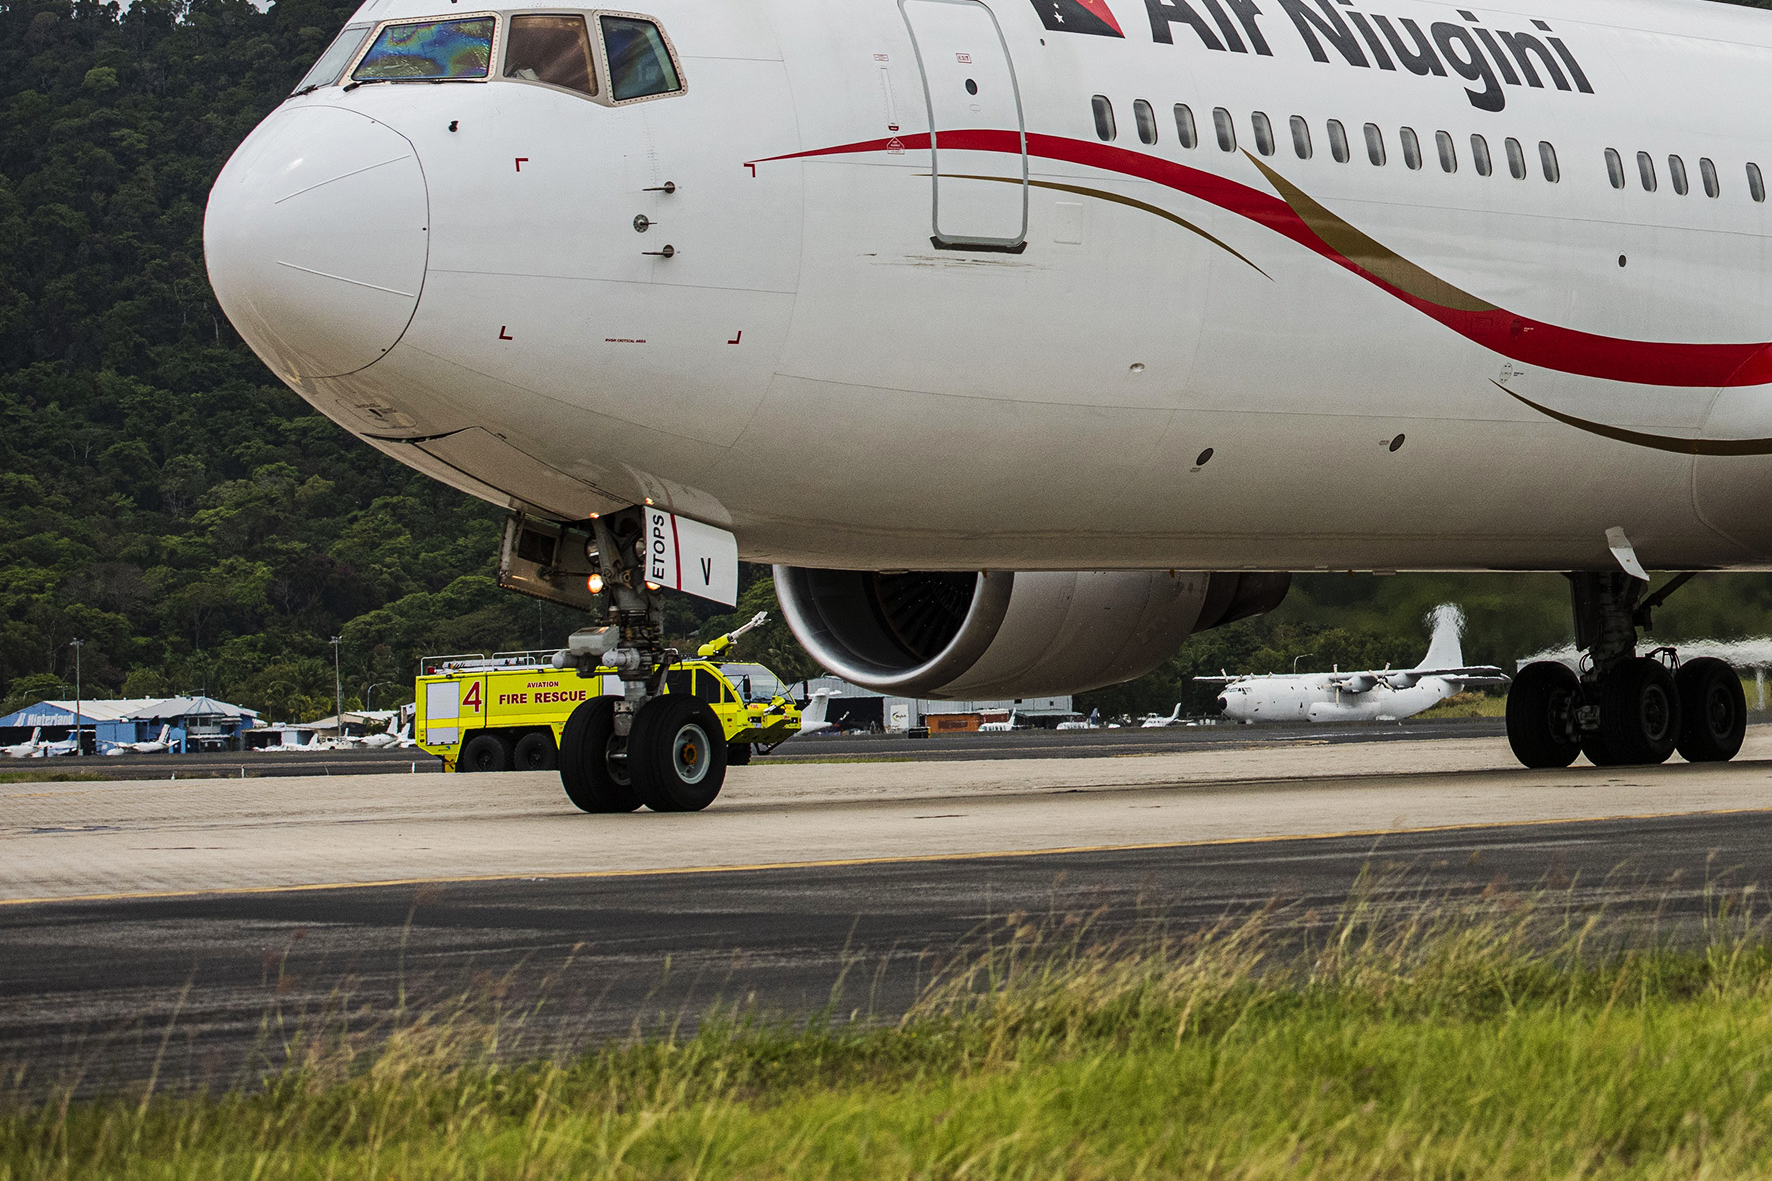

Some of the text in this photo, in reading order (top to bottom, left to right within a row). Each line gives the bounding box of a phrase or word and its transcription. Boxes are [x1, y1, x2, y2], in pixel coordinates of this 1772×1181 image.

[652, 514, 666, 580] ETOPS
[700, 557, 712, 586] V
[526, 681, 559, 689] AVIATION
[462, 681, 482, 713] 4
[498, 690, 587, 705] FIRE RESCUE
[27, 712, 75, 727] Hinterland
